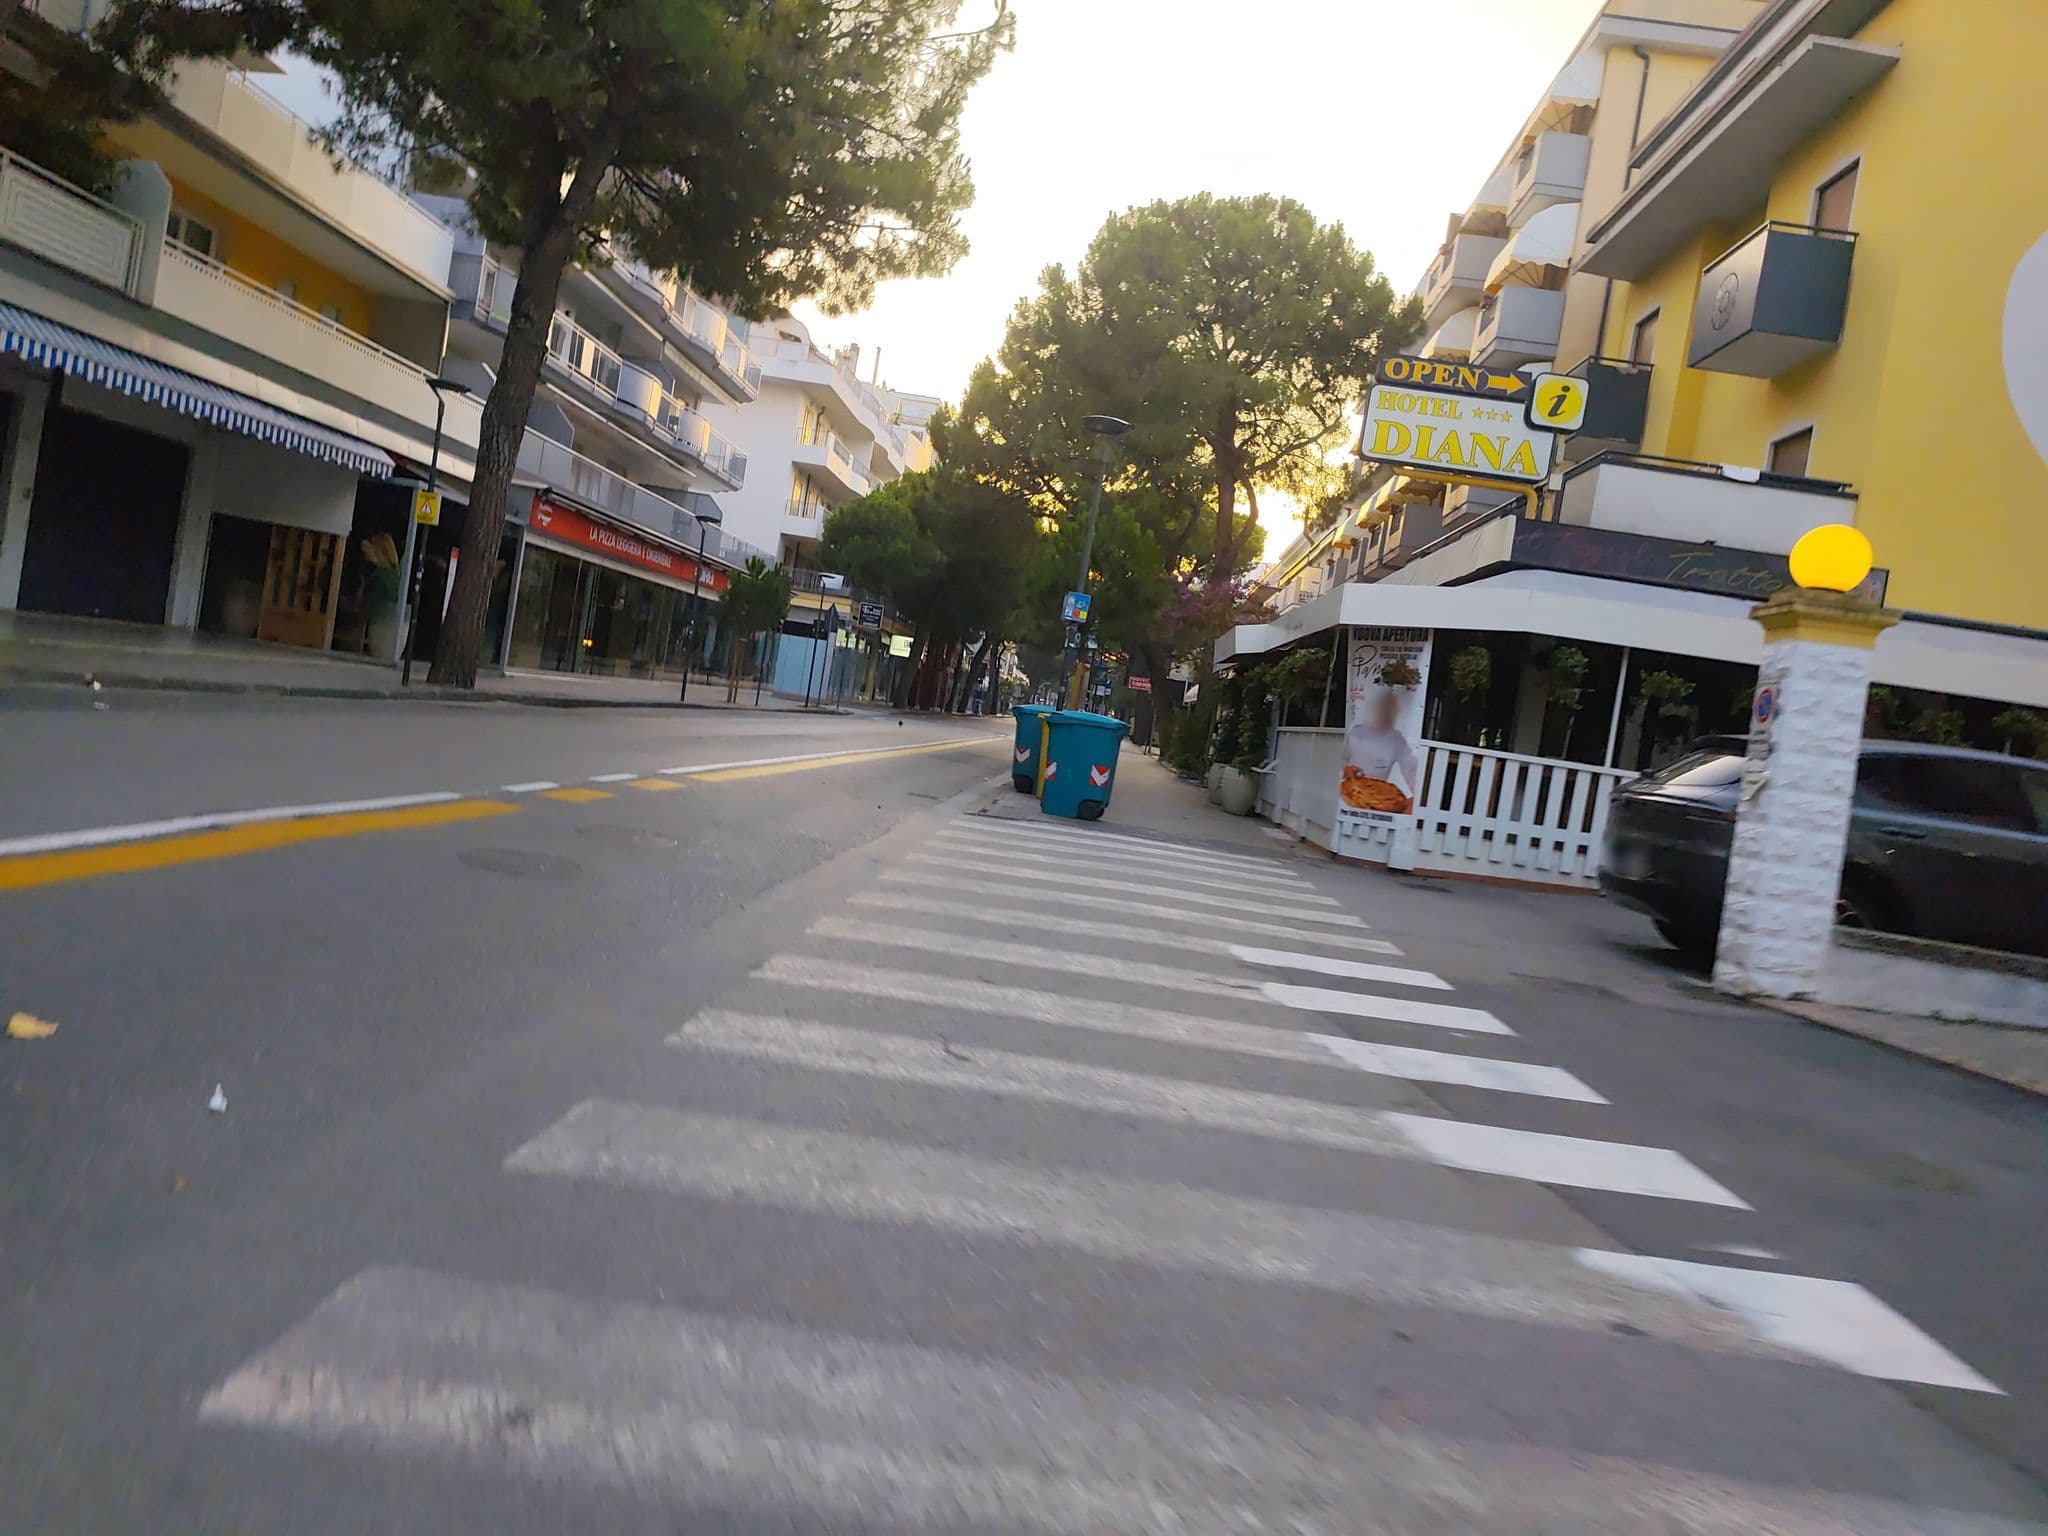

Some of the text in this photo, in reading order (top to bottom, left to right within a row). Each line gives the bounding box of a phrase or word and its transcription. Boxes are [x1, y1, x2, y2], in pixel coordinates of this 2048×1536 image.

[1384, 358, 1482, 391] OPEN
[1376, 389, 1463, 420] HOTEL
[1369, 420, 1540, 475] DIANA
[598, 529, 616, 549] PIZZA
[1666, 552, 1785, 591] Tratto
